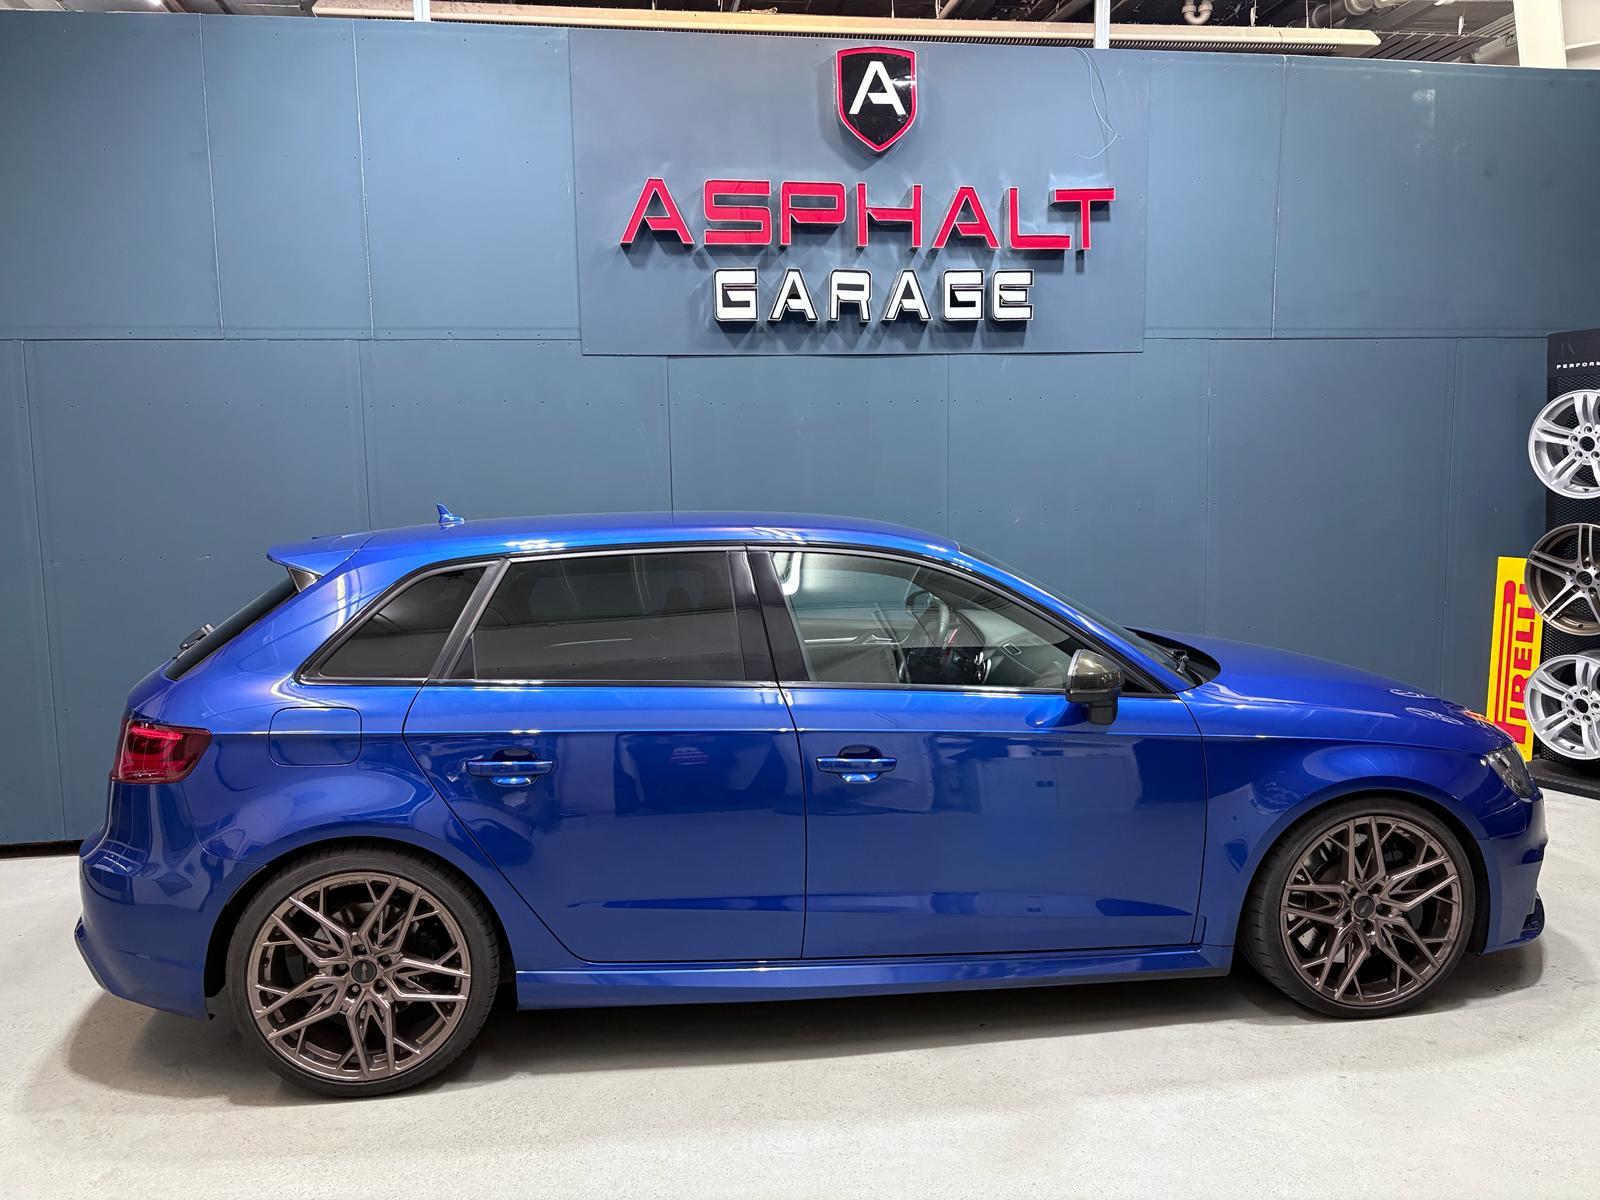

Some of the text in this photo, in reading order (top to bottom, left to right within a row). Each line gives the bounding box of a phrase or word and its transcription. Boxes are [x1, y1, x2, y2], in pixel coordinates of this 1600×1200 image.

[849, 61, 906, 115] A
[620, 177, 1115, 250] ASPHALT
[713, 267, 1034, 322] GARAGE
